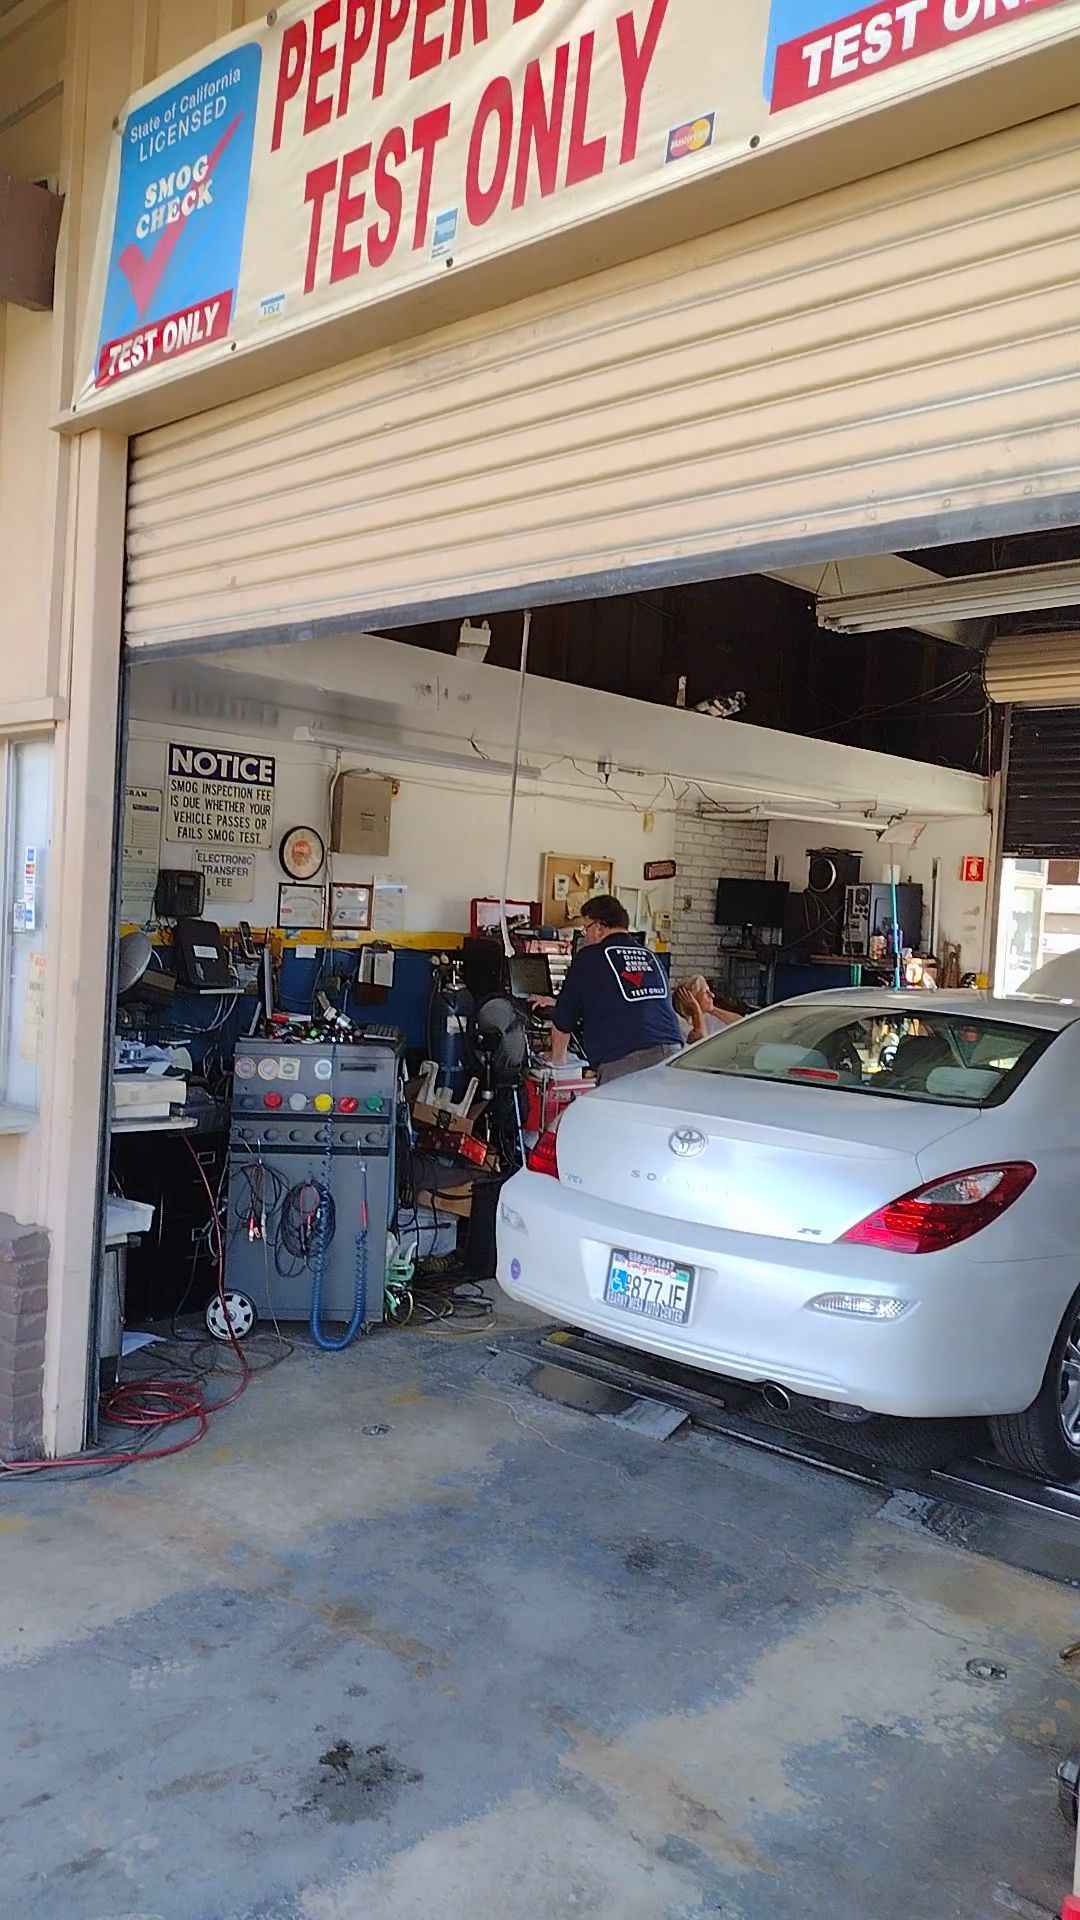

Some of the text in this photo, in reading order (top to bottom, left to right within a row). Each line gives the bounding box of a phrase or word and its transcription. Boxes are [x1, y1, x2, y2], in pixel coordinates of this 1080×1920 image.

[802, 0, 927, 88] TEST
[130, 68, 241, 143] State of California
[139, 95, 227, 162] LICENSED
[303, 0, 670, 295] TEST ONLY
[144, 154, 209, 209] SMOG
[136, 179, 213, 239] CHECK
[108, 302, 220, 376] TEST ONLY
[172, 748, 272, 782] NOTICE
[170, 795, 271, 816] IS DUE WHETHER YOUR
[171, 779, 271, 801] SMOG INSPECTION FEE
[173, 810, 267, 830] VEHICLE PASSES OR
[177, 826, 262, 844] FAILS SMOG TEST.
[197, 852, 253, 865] ELECTRONIC
[202, 865, 248, 876] TRANSFER
[215, 877, 233, 887] FEE
